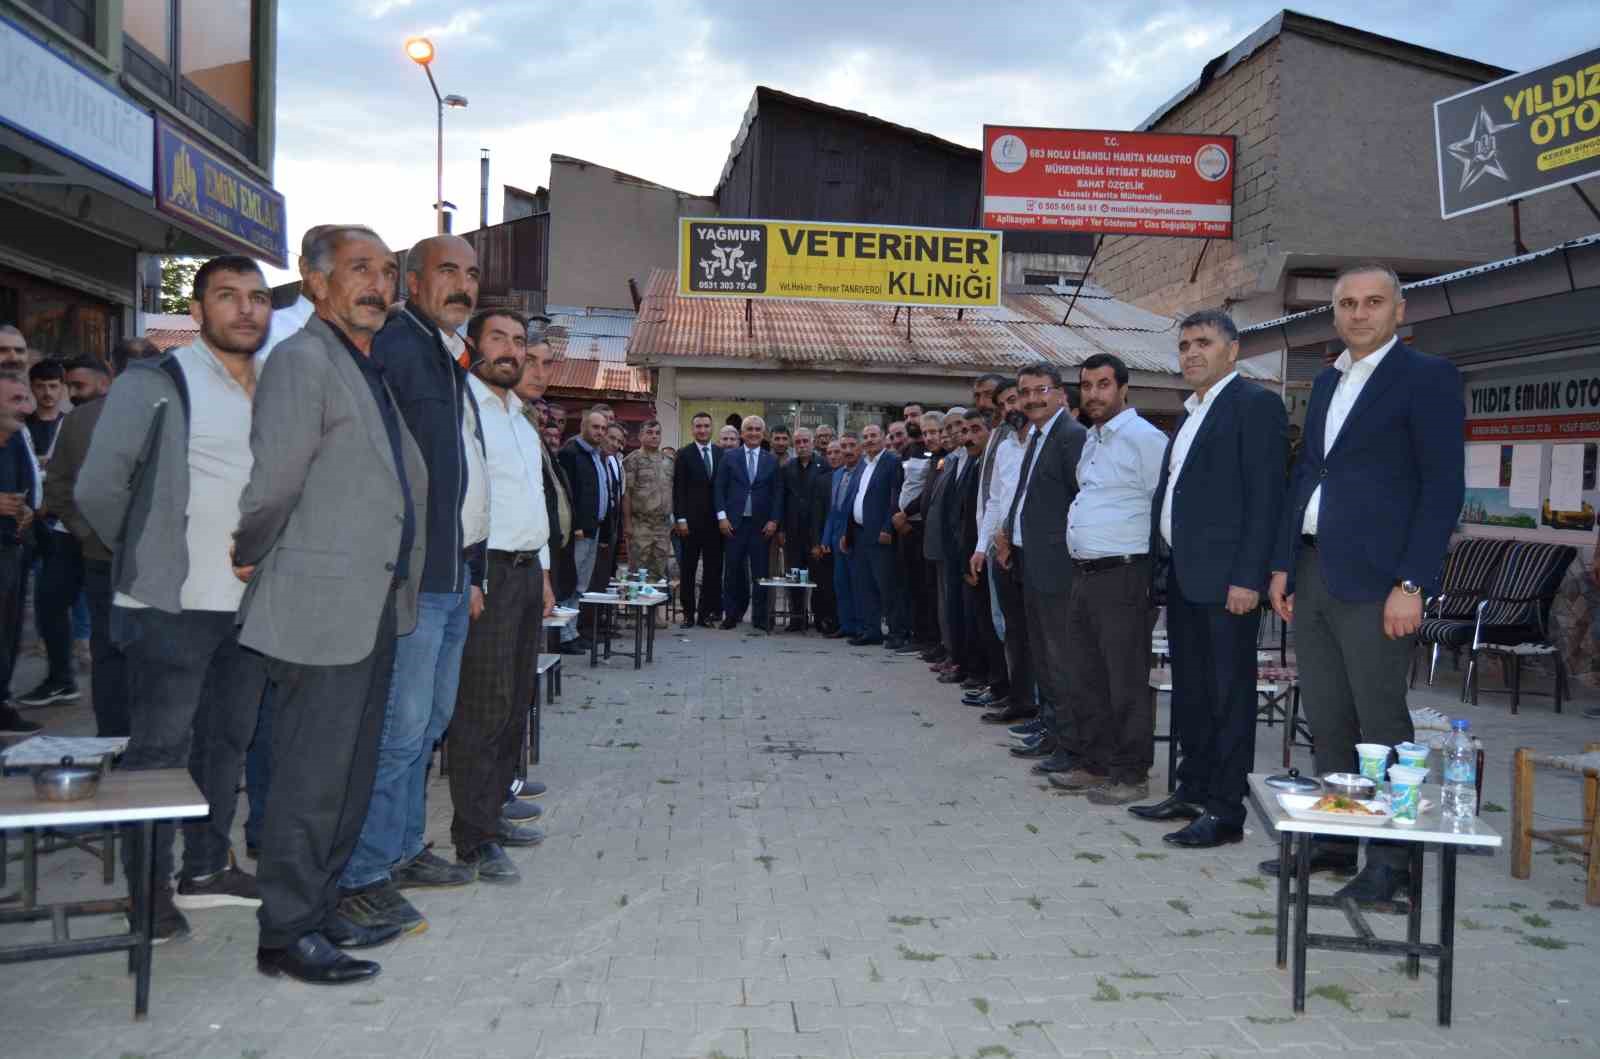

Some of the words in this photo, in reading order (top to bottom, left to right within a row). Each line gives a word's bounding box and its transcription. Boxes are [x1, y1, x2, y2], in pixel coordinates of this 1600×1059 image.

[1504, 63, 1600, 121] YILDIZ
[1530, 99, 1600, 145] OTO
[1044, 163, 1104, 176] MÜHENDİSLİK
[1047, 149, 1071, 160] NOLU
[1072, 149, 1111, 161] LİSANSLI
[1146, 153, 1192, 165] KADASTRO
[696, 226, 761, 242] YAĞMUR
[1471, 386, 1511, 414] YILDIZ
[1515, 381, 1561, 411] EMLAK
[1566, 377, 1600, 409] OTO
